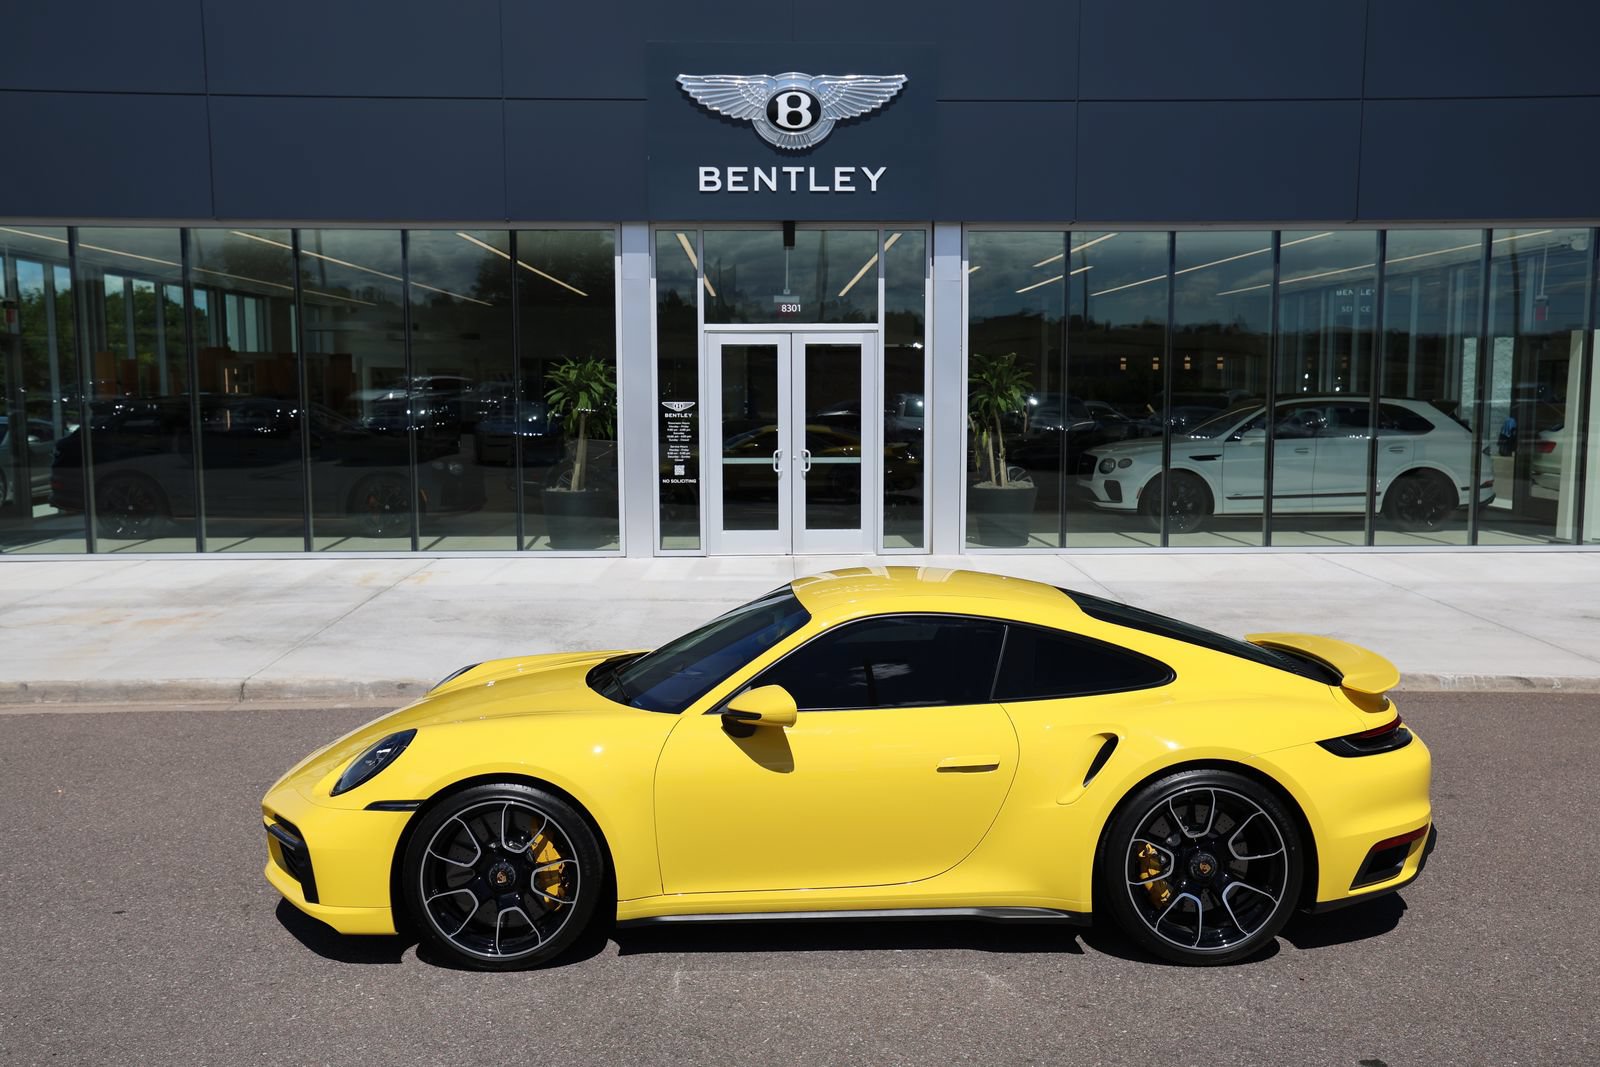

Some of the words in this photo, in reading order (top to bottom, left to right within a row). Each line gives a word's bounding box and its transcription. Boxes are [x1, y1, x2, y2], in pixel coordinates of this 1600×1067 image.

[776, 91, 812, 129] B
[698, 166, 887, 192] BENTLEY
[781, 304, 801, 312] 8301
